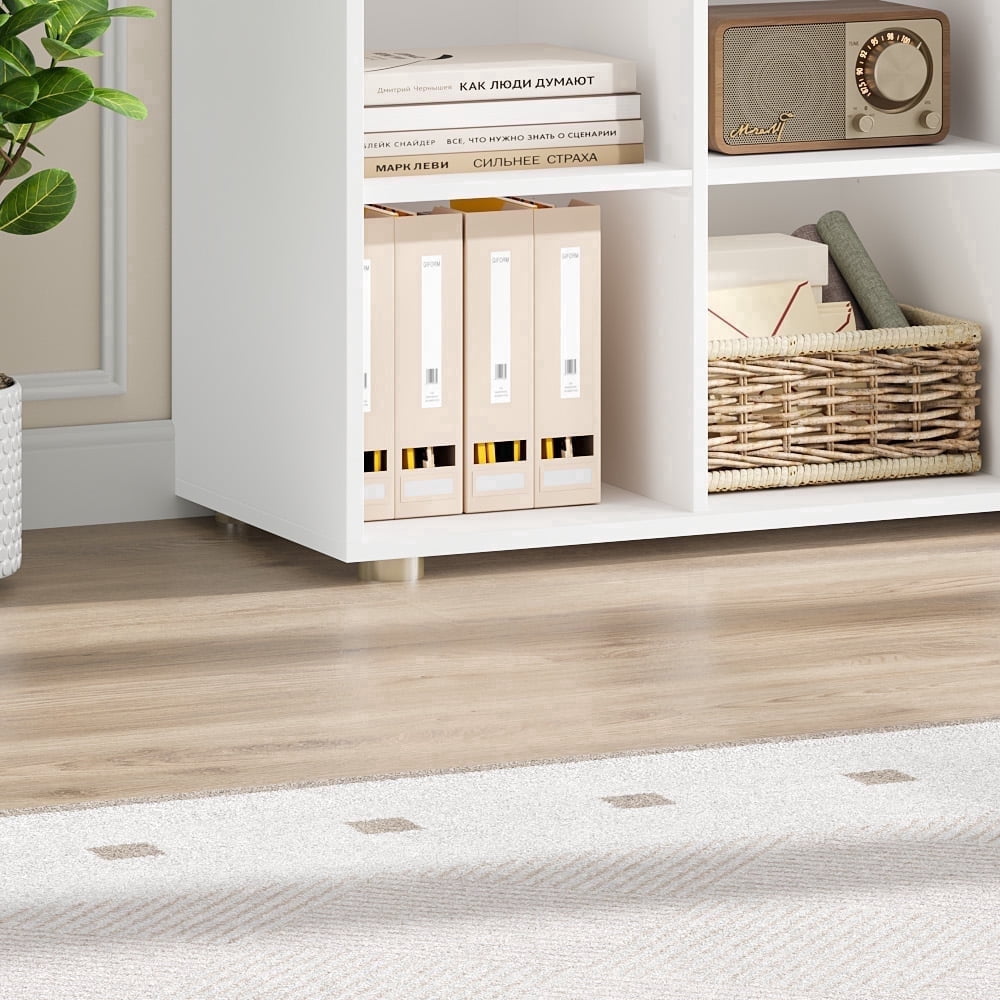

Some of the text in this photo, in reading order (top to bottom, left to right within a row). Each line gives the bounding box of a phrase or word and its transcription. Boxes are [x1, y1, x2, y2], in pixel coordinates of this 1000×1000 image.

[870, 36, 879, 47] 95
[859, 50, 868, 59] 92
[856, 67, 864, 76] 90
[376, 86, 411, 94] Дмитрий
[459, 82, 486, 91] КАК
[490, 79, 532, 90] ЛЮДИ
[535, 75, 595, 89] ДУМАЮТ
[394, 139, 436, 148] СНАЙДЕР
[446, 137, 466, 145] ВСЕ,
[489, 135, 525, 143] НУЖНО
[527, 133, 555, 141] ЗНАТЬ
[567, 130, 617, 139] СЦЕНАРИИ
[376, 152, 598, 173] МАРК ЛЕВИ СИЛЬНЕЕ СТРАХА
